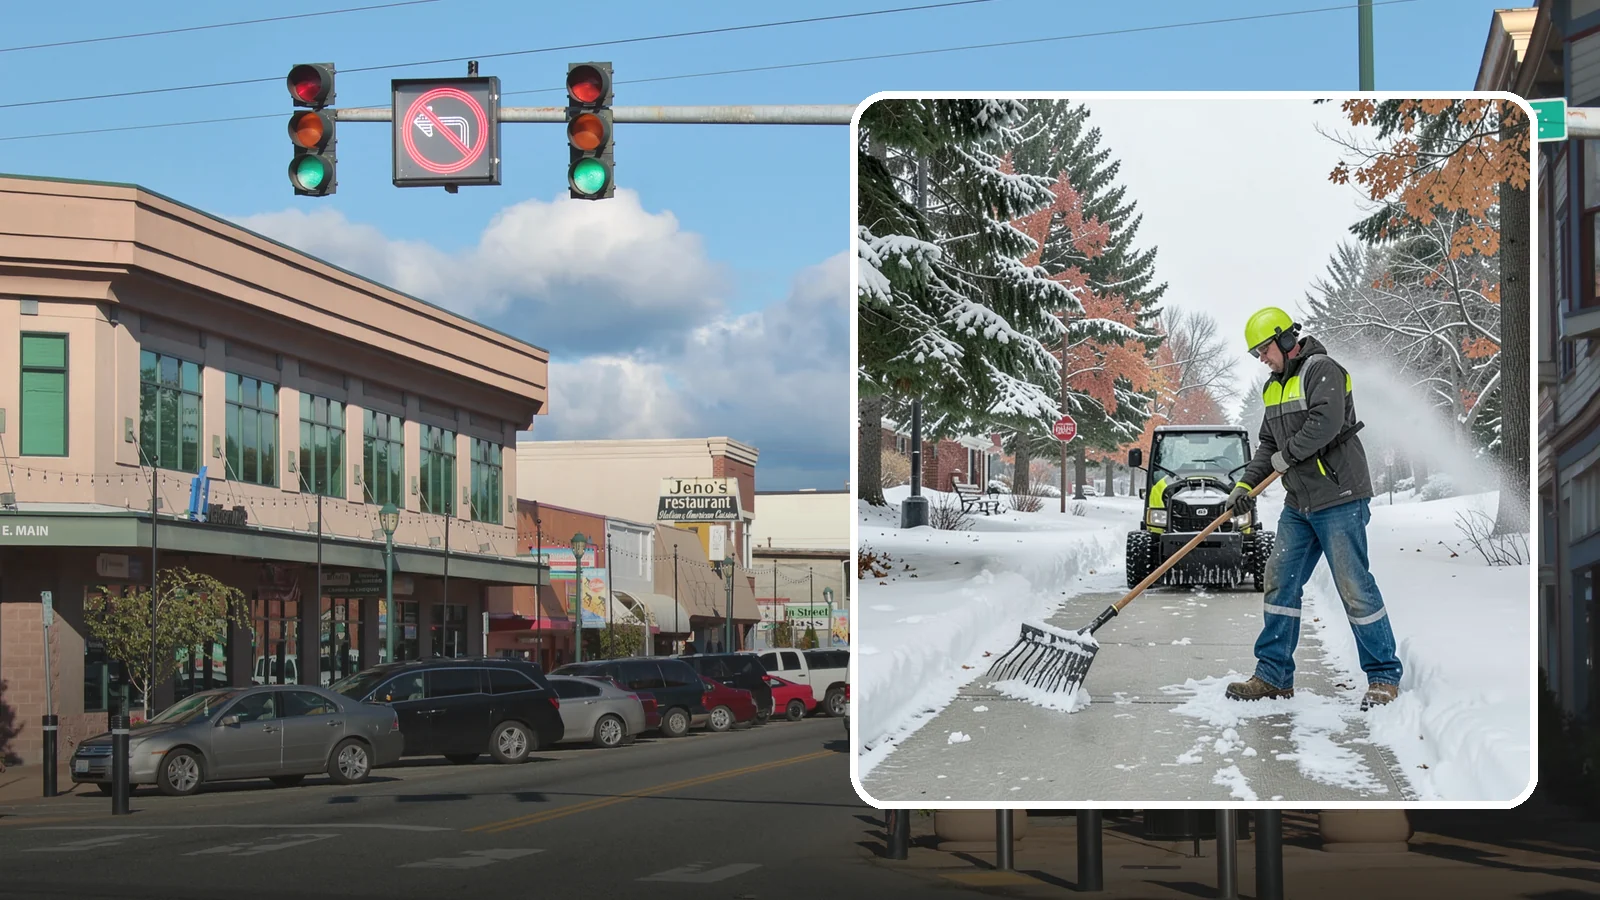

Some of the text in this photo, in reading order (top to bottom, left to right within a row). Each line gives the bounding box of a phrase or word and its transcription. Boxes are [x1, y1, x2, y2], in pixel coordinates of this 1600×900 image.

[669, 480, 728, 495] Jeno's
[665, 496, 731, 509] restaurant
[658, 509, 681, 520] Italian
[686, 509, 714, 519] American
[714, 509, 738, 519] Cuisine
[2, 525, 49, 537] E. MAIN
[785, 607, 795, 617] in
[797, 607, 829, 616] Street
[790, 619, 824, 627] lass
